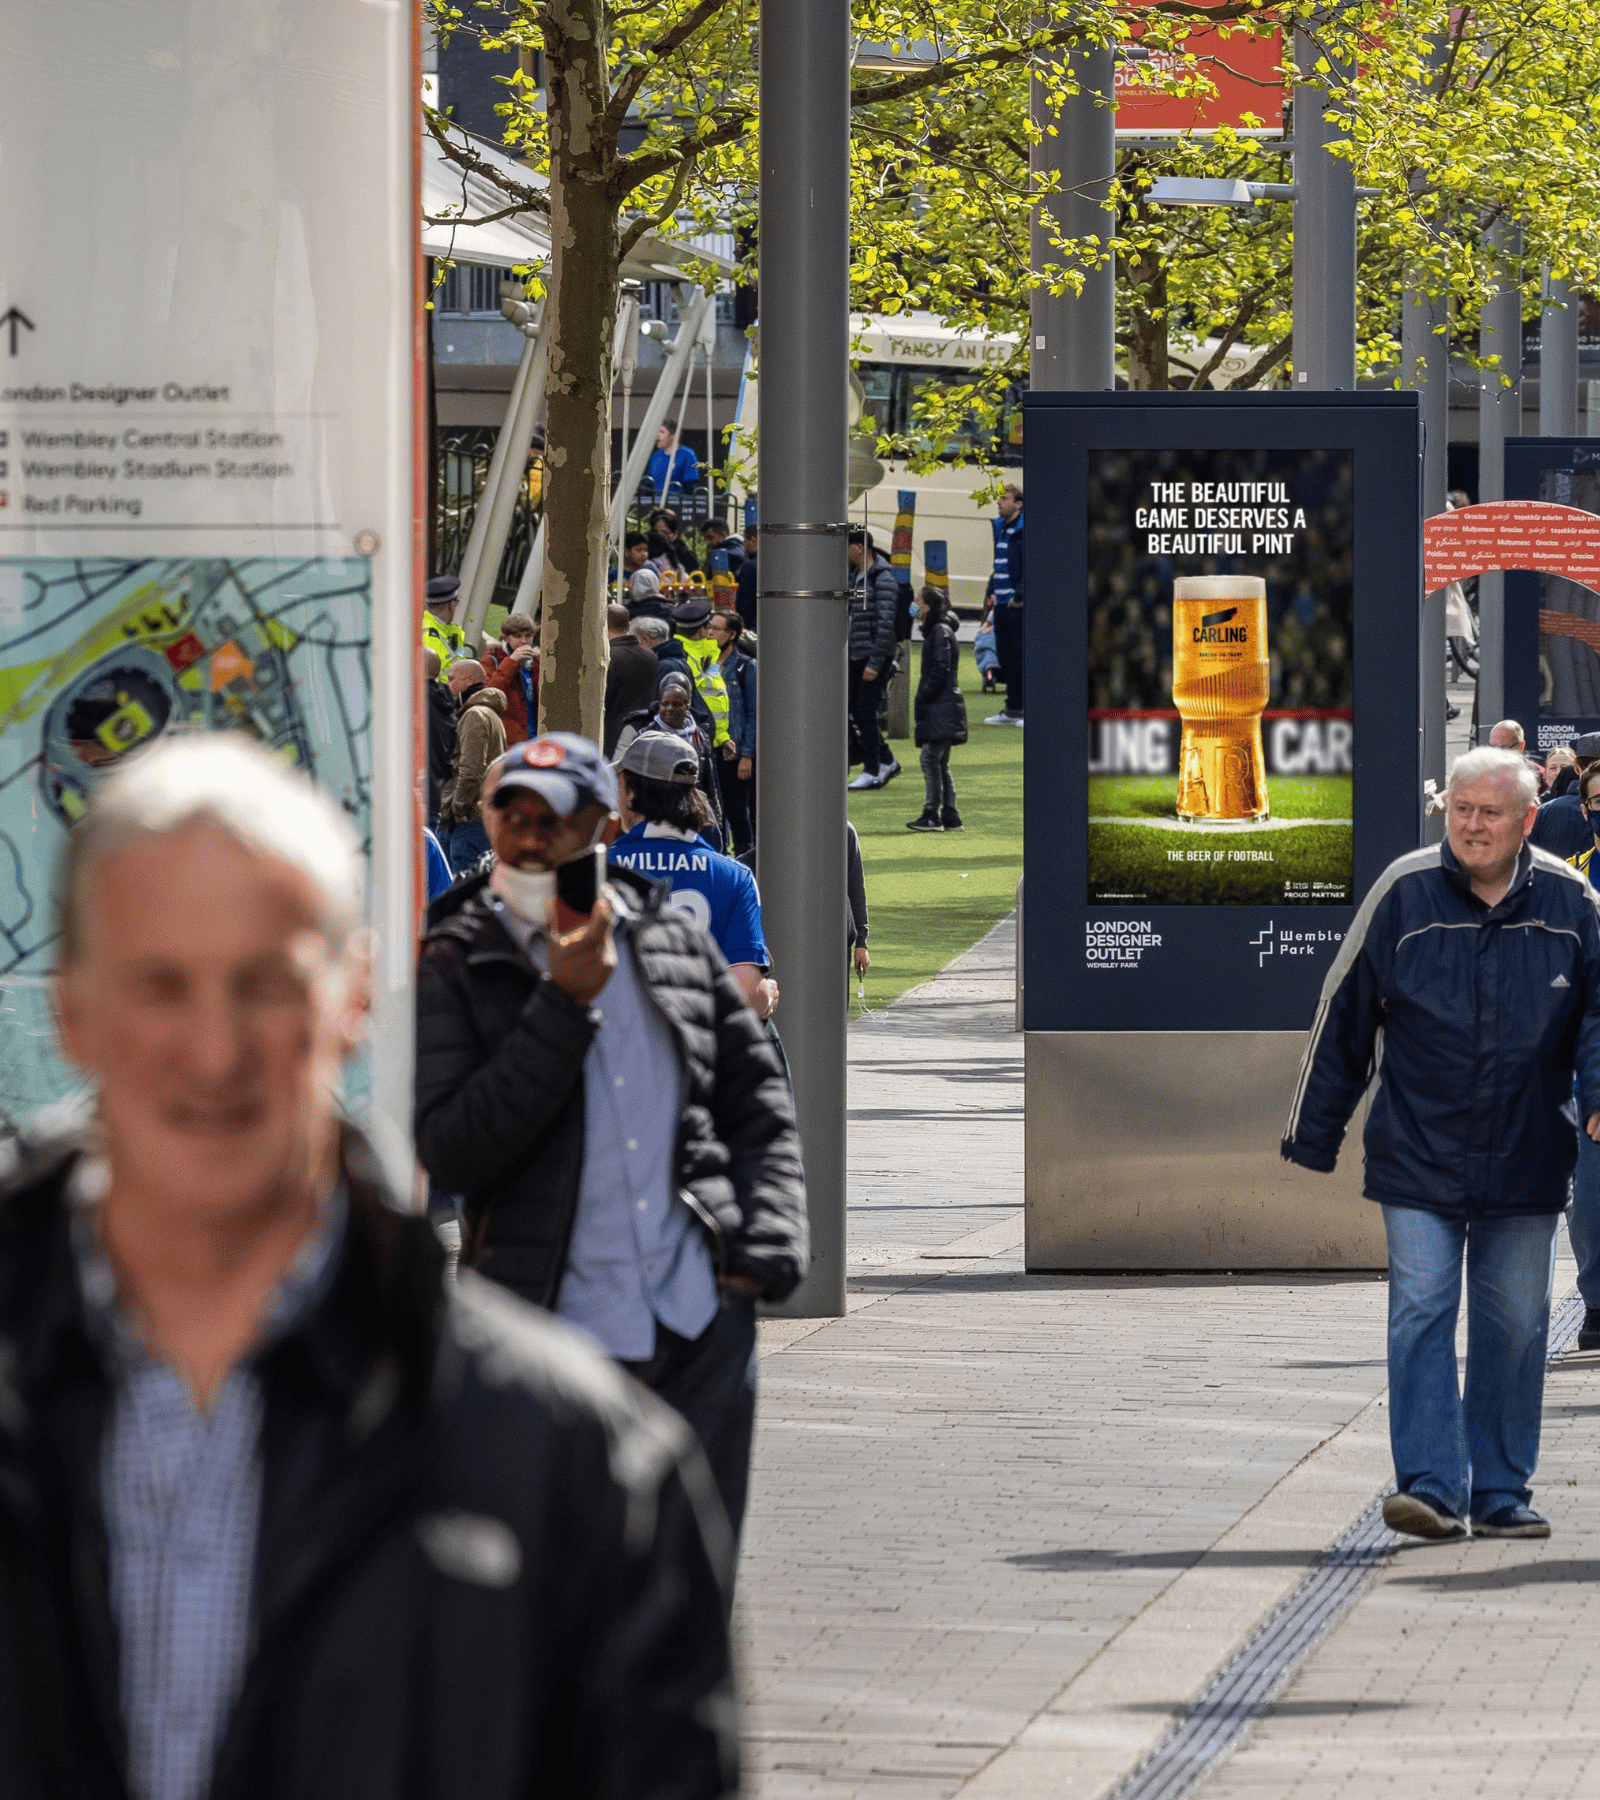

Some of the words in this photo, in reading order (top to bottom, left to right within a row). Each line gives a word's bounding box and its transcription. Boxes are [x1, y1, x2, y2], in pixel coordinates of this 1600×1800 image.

[890, 342, 946, 358] FANCY
[953, 345, 977, 359] AN
[981, 345, 1005, 361] ICE
[69, 382, 157, 407] Designer
[162, 382, 231, 403] Outlet
[21, 430, 118, 450] Wembley
[122, 429, 200, 448] Central
[204, 430, 284, 448] Station
[21, 460, 118, 481] Wembley
[122, 460, 211, 479] Stadium
[215, 460, 294, 479] Station
[1151, 482, 1185, 503] THE
[1192, 482, 1290, 503] BEAUTIFUL
[23, 495, 60, 515] Red
[65, 495, 142, 517] Parking
[1135, 508, 1189, 529] GAME
[1195, 507, 1289, 529] DESERVES
[1293, 508, 1307, 529] A
[1147, 533, 1247, 554] BEAUTIFUL
[1253, 533, 1294, 554] PINT
[1193, 627, 1247, 643] CARLING
[1537, 725, 1575, 733] LONDON
[616, 852, 708, 871] WILLIAN
[1167, 850, 1184, 861] THE
[1187, 850, 1211, 861] BEER
[1213, 850, 1225, 861] OF
[1228, 850, 1274, 861] FOOTBALL
[1086, 921, 1151, 933] LONDON
[1086, 934, 1162, 947] DESIGNER
[1280, 944, 1315, 955] Park
[1086, 948, 1144, 960] OUTLET
